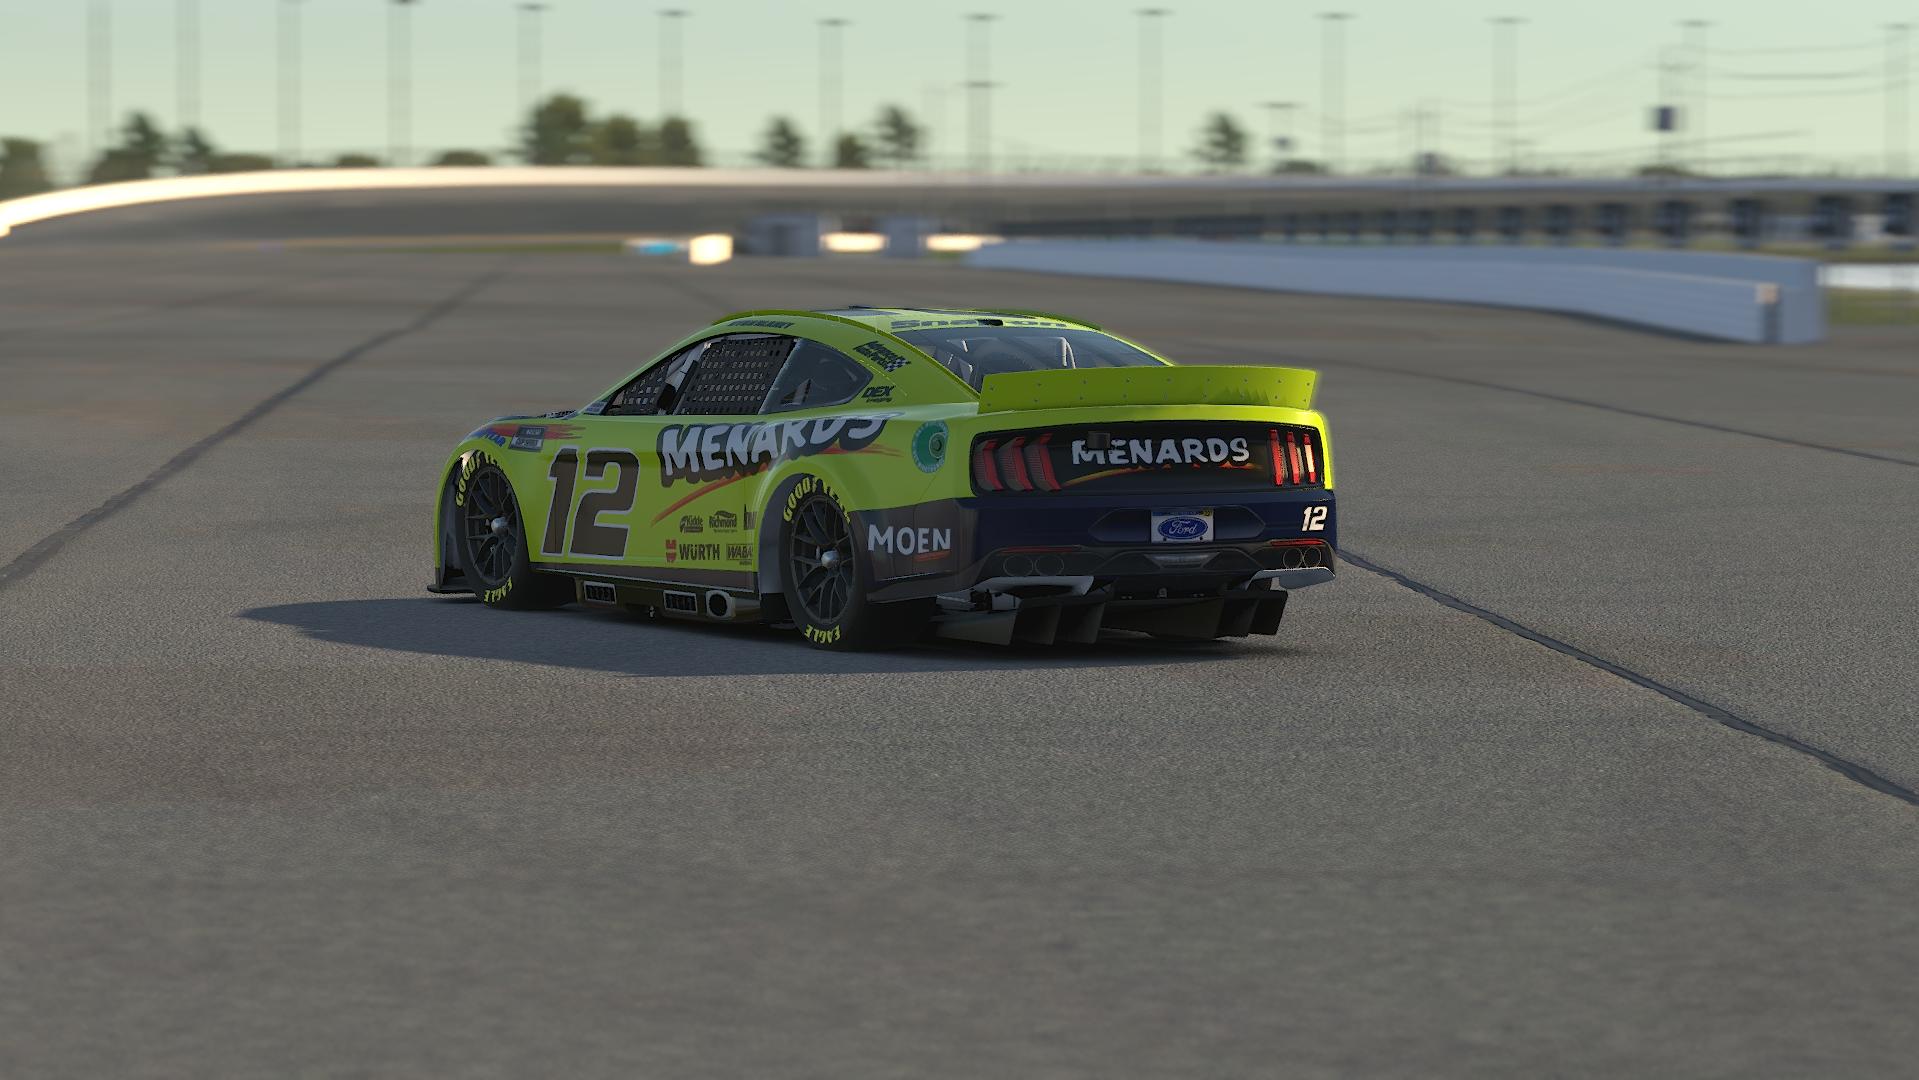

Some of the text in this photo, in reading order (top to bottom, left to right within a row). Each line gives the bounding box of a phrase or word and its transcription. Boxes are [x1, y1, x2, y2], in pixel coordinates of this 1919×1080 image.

[659, 414, 890, 483] MENARDS
[1071, 437, 1250, 465] MENARDS
[542, 444, 641, 561] 12
[708, 514, 738, 529] Richmond
[1168, 520, 1198, 535] Ford
[1300, 505, 1328, 532] 12
[867, 523, 952, 556] MOEN
[483, 576, 514, 603] EAGLE
[804, 623, 841, 645] EAGLE
